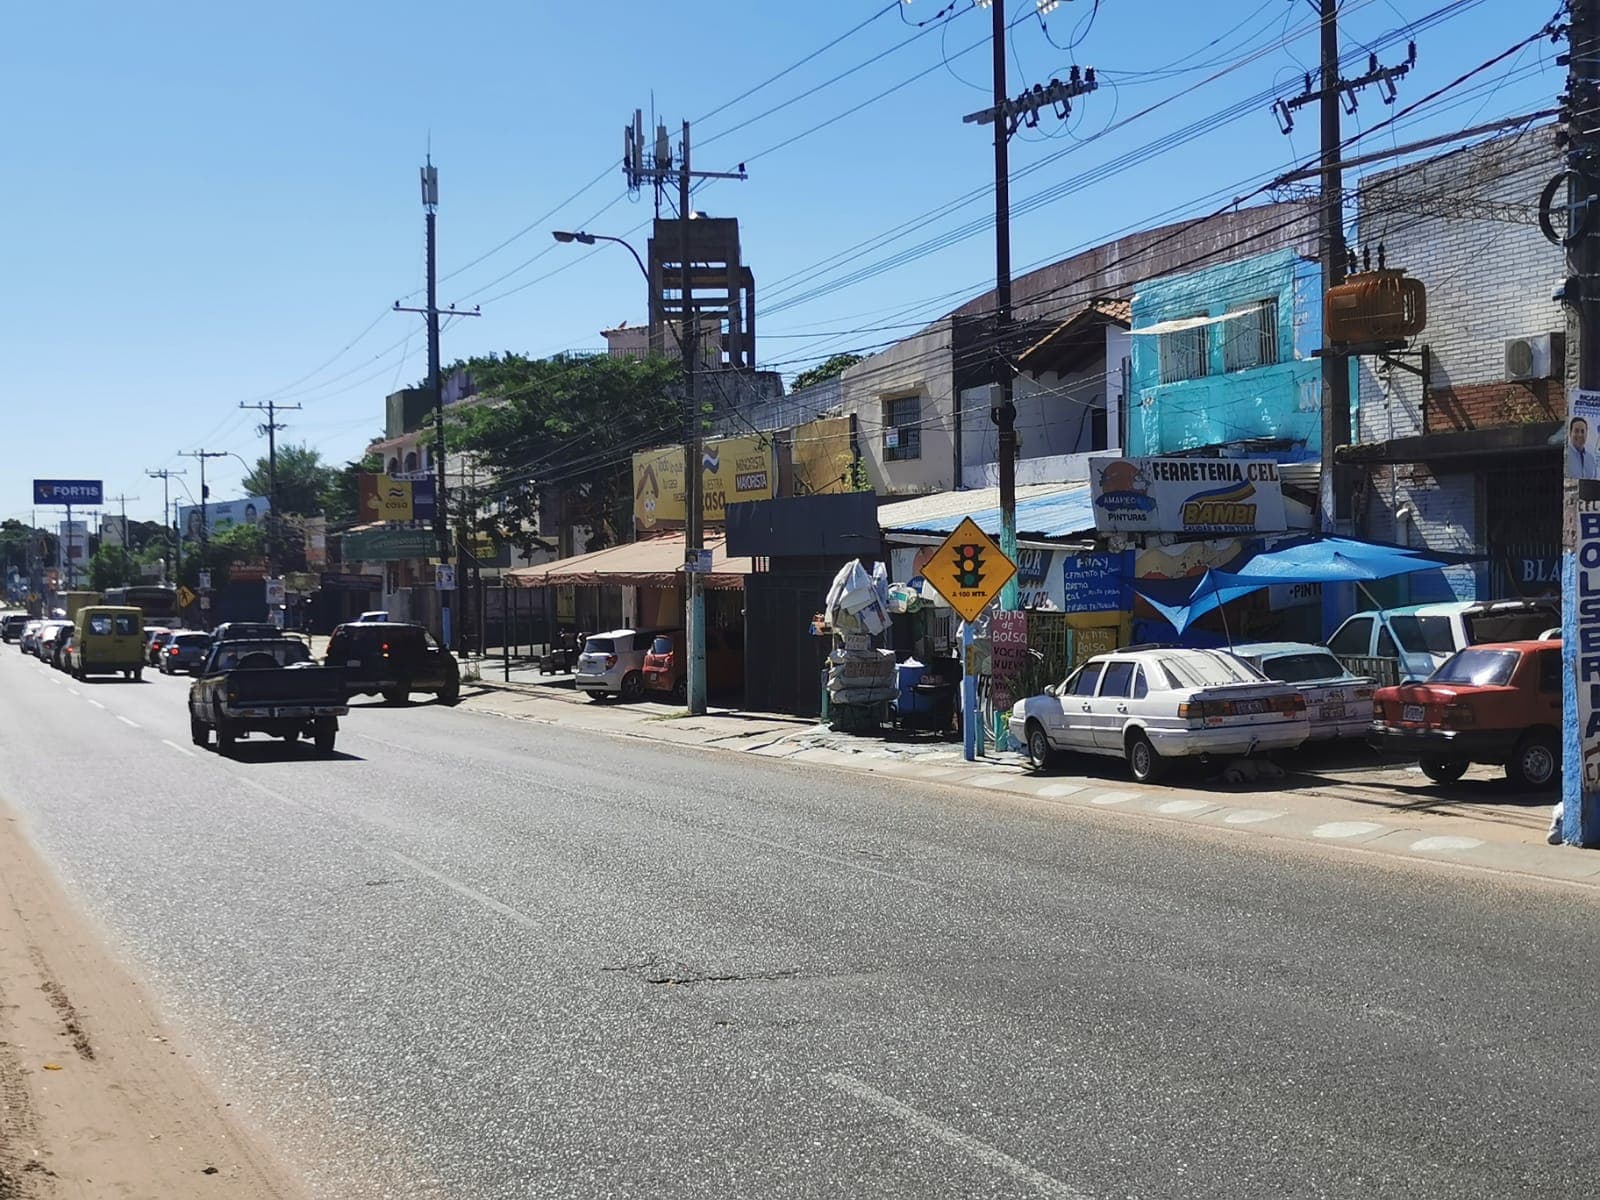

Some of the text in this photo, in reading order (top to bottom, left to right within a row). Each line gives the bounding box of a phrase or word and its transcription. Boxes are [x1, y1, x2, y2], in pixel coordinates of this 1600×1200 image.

[736, 455, 766, 471] MINORISTA
[1152, 462, 1279, 482] FERRETERIA CEL
[736, 473, 768, 491] MAYORISTA
[53, 486, 99, 496] FORTIS
[385, 500, 408, 510] casa
[704, 491, 725, 512] asa
[1107, 512, 1148, 522] PINTURAS
[1182, 502, 1257, 526] BAMBI
